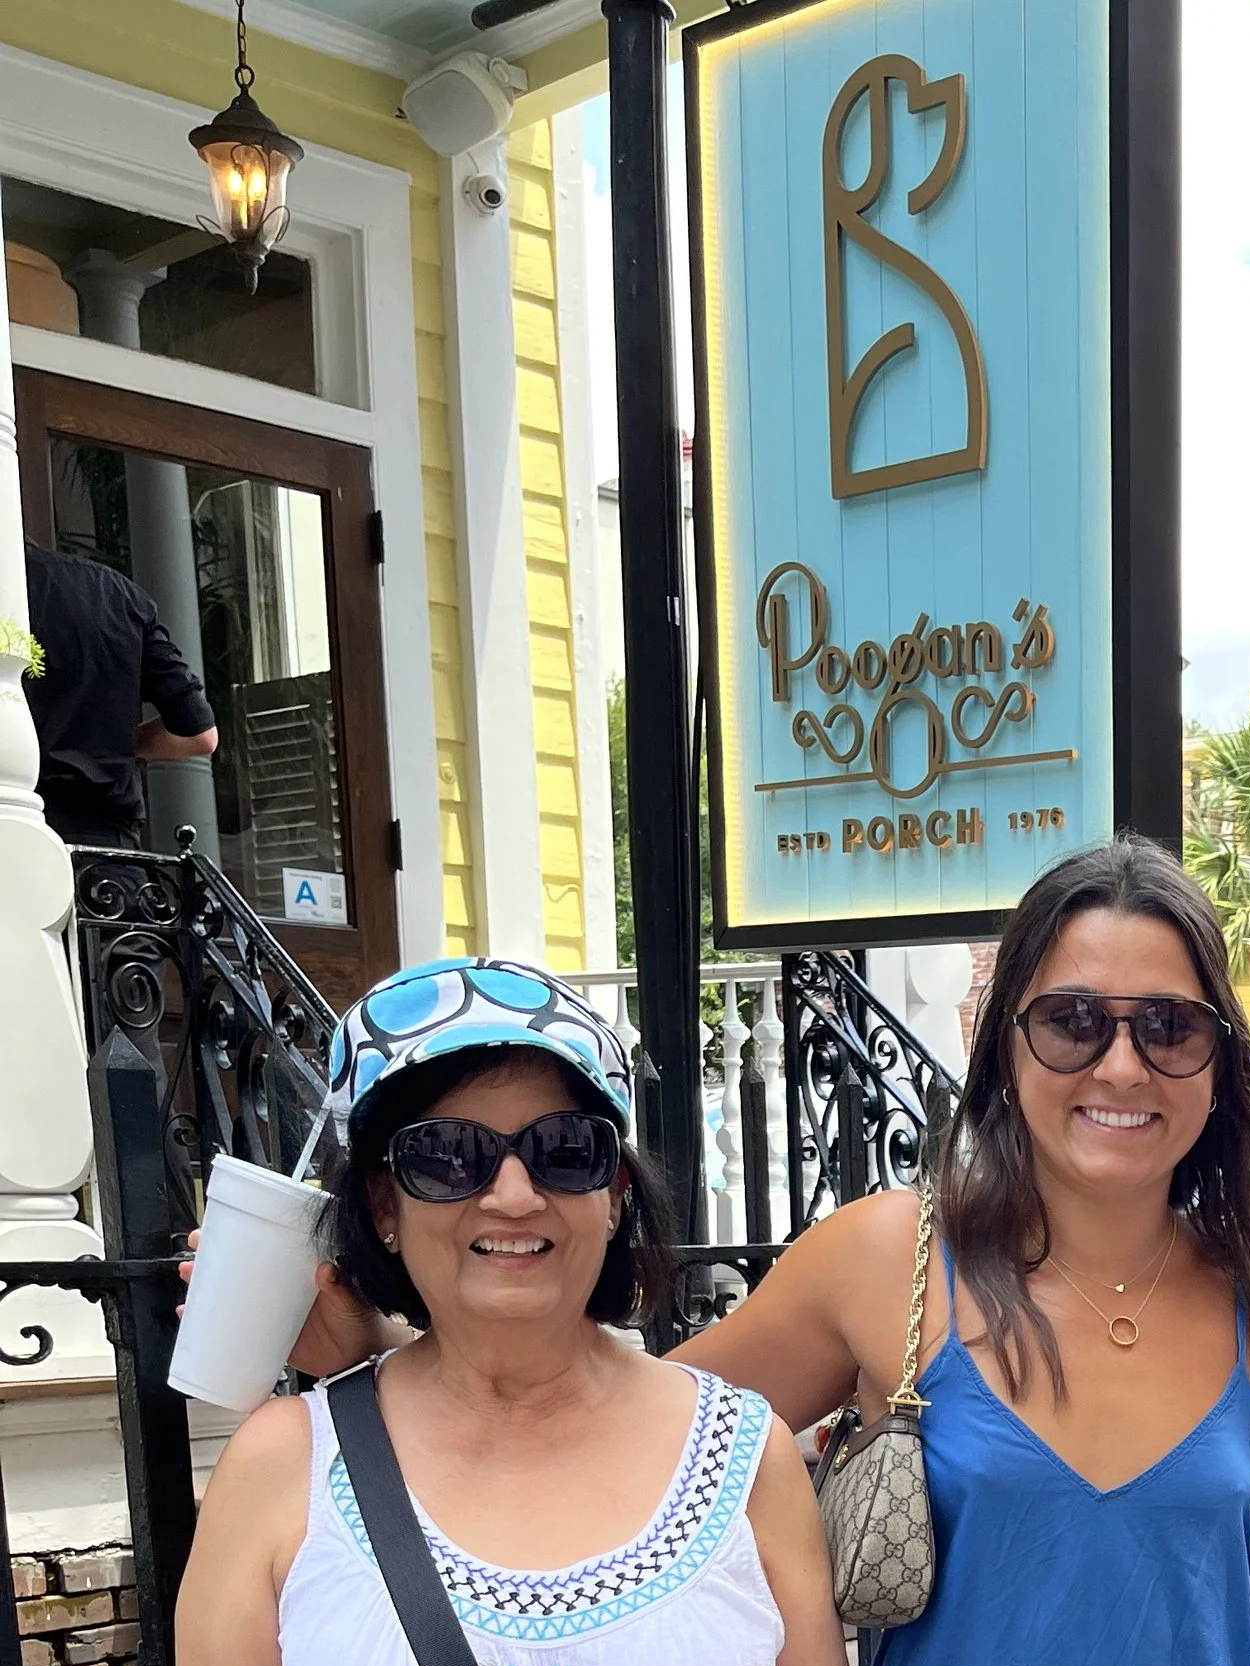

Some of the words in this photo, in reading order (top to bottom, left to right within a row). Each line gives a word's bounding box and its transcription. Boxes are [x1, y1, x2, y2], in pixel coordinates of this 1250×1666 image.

[756, 561, 1056, 798] Poogan's
[777, 831, 831, 854] ESTD
[842, 807, 984, 854] PORCH
[1007, 807, 1065, 832] 1976
[295, 880, 318, 905] A
